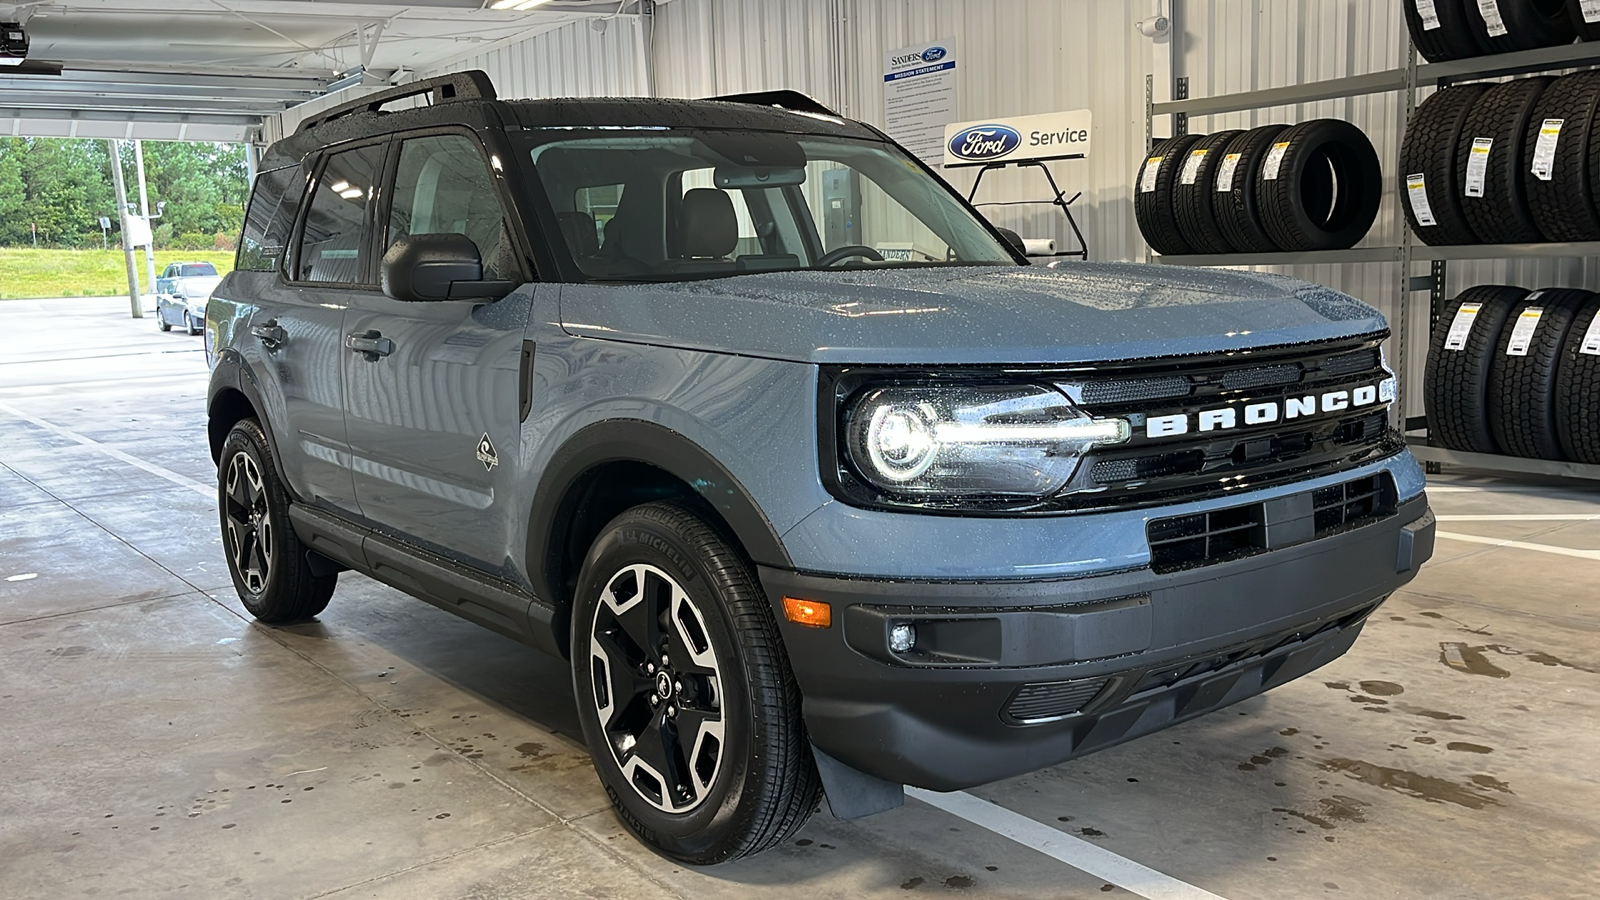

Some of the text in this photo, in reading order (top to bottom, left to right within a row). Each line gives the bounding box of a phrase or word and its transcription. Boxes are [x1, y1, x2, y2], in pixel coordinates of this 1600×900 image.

[891, 52, 922, 66] SANDERS
[925, 49, 942, 61] Ford
[894, 70, 915, 79] MISSION
[915, 64, 944, 75] STATEMENT
[961, 127, 1088, 156] Ford Service
[1146, 385, 1376, 439] BRONCO
[639, 532, 695, 580] MICHELIN
